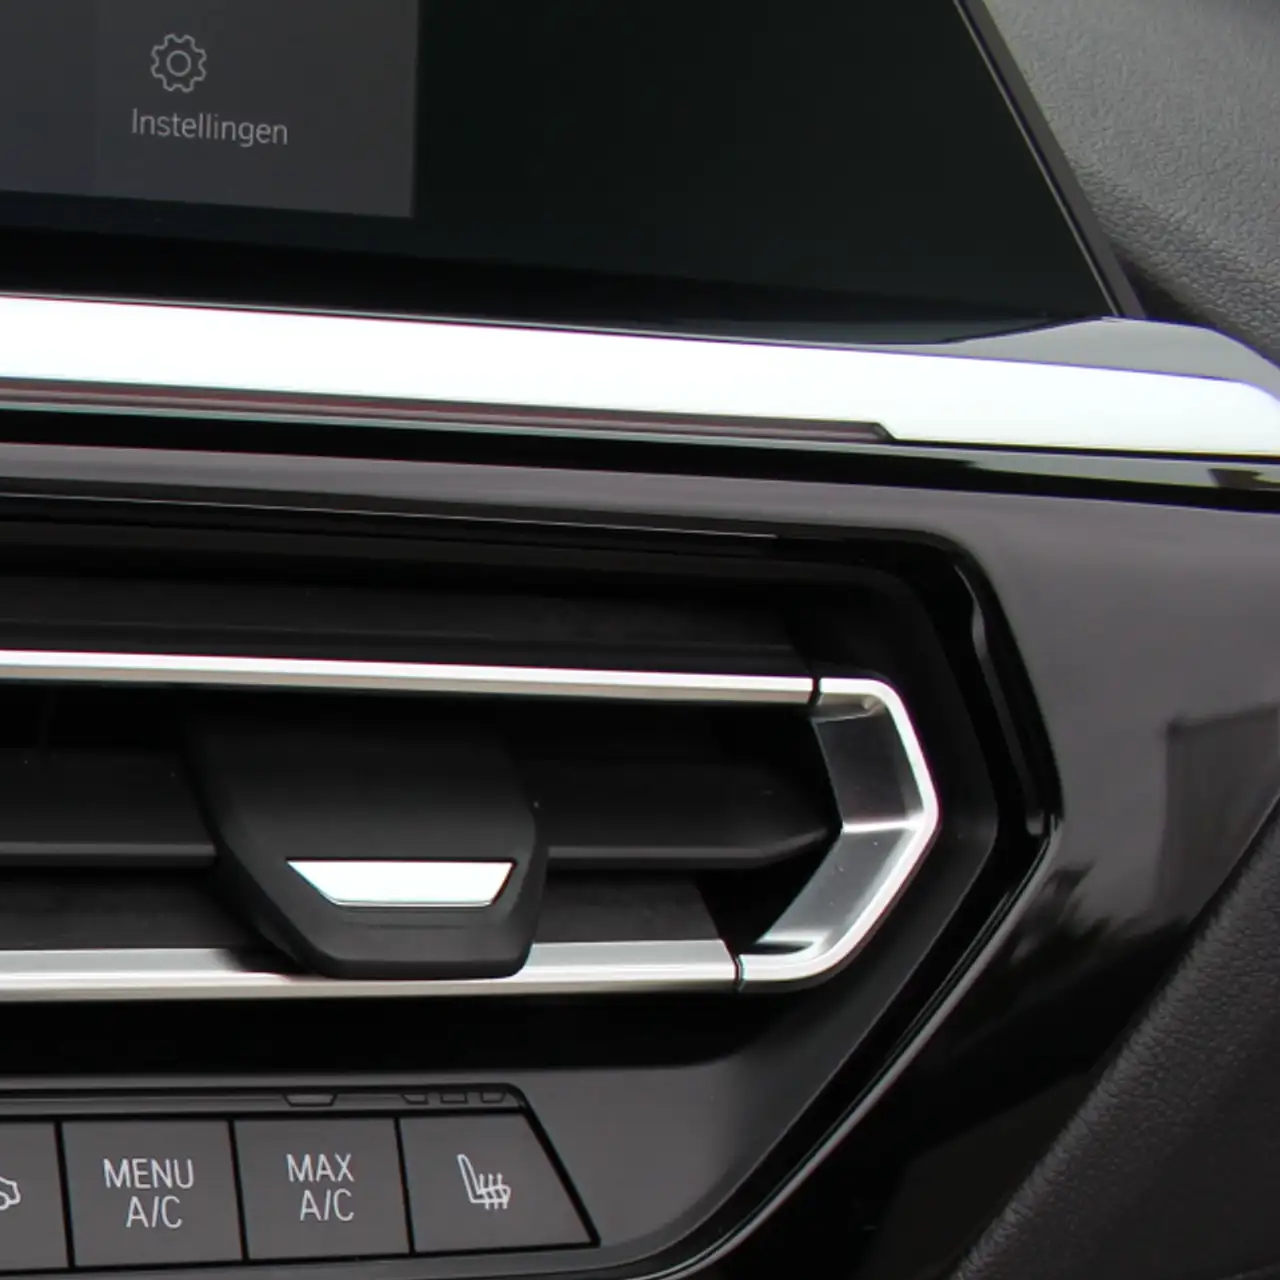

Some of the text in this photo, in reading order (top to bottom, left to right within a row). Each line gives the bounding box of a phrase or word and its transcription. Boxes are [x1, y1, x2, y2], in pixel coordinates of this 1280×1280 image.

[132, 107, 288, 148] Instellingen
[103, 1158, 194, 1189] MENU
[286, 1153, 355, 1183] MAX
[125, 1195, 183, 1229] A/C
[300, 1188, 355, 1222] A/C
